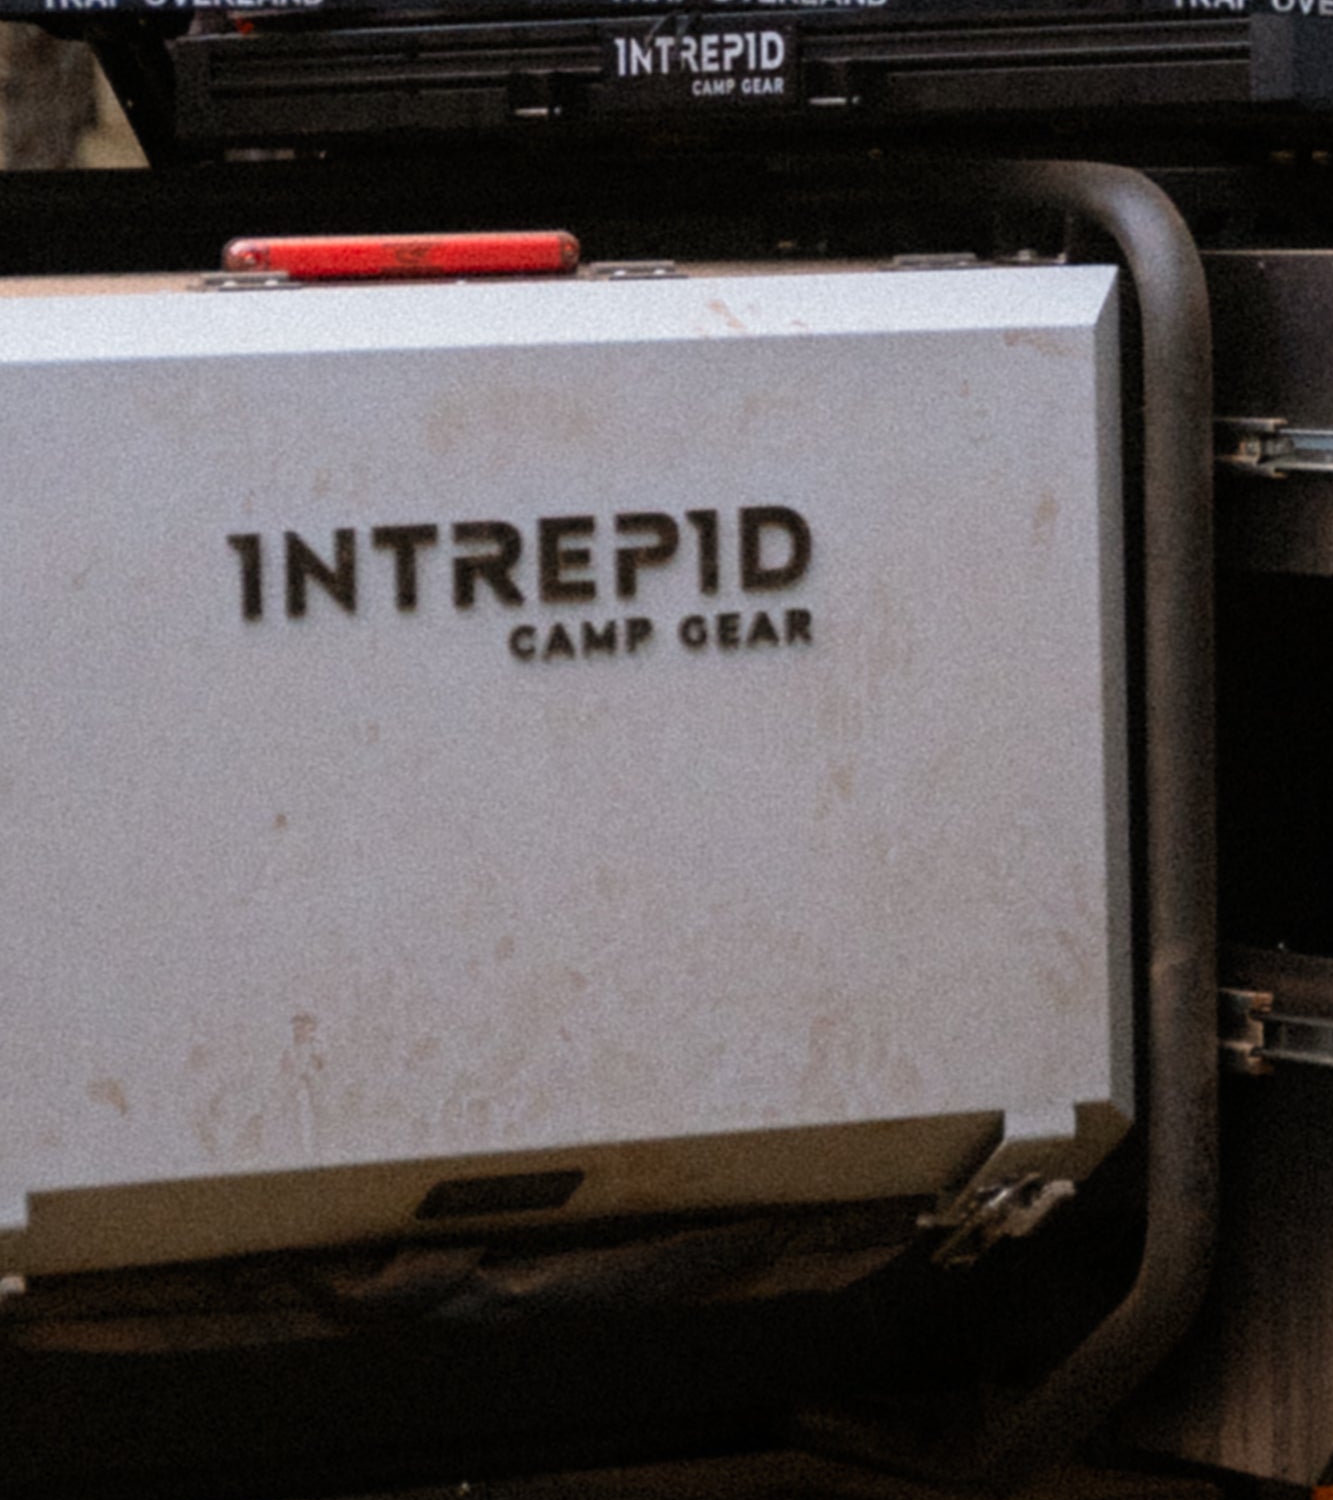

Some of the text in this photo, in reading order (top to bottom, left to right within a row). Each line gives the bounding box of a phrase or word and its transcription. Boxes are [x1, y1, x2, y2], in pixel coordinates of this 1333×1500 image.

[614, 30, 785, 77] INTREPID
[692, 76, 785, 96] CAMP GEAR
[226, 504, 813, 623] INTREPID
[508, 607, 815, 662] CAMP GEAR
